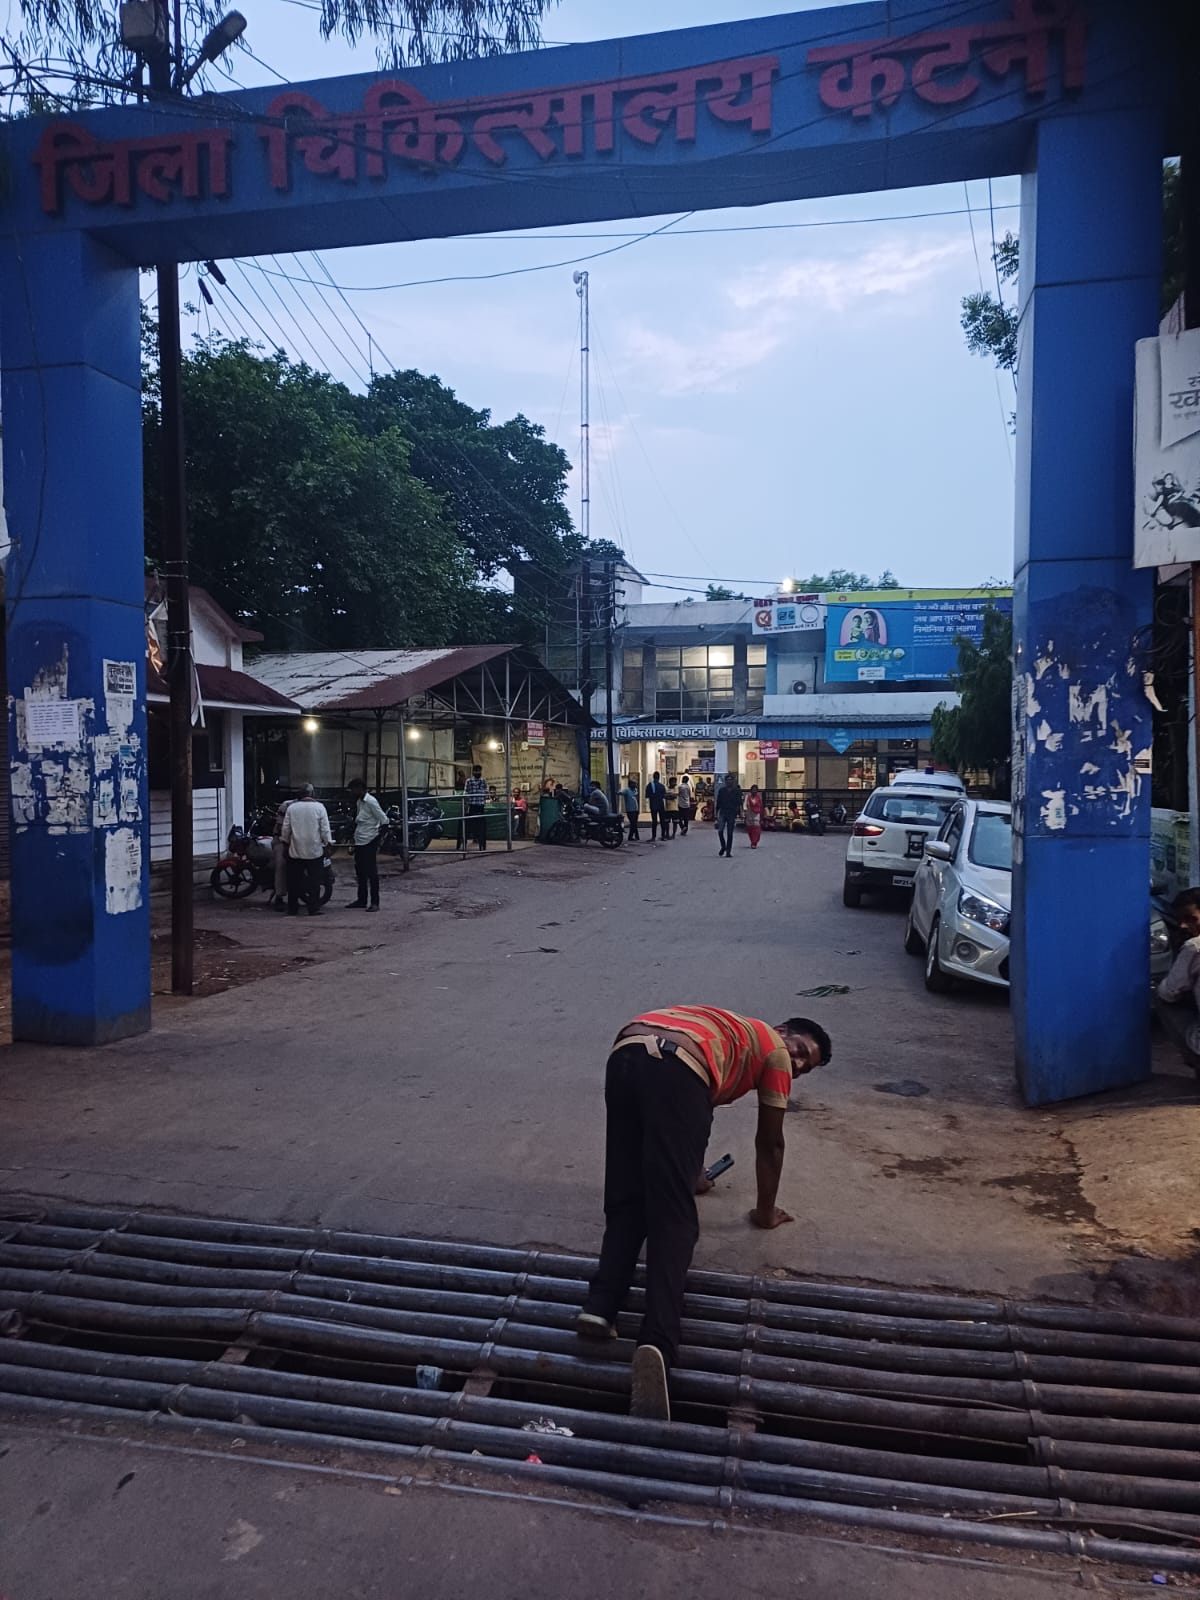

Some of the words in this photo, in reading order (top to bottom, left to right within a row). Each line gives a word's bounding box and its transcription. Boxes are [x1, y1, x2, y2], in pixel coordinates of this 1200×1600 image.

[34, 122, 231, 214] जिला
[259, 57, 779, 190] चिकित्सालय
[807, 0, 1088, 117] कटनी
[681, 725, 710, 737] कटनी
